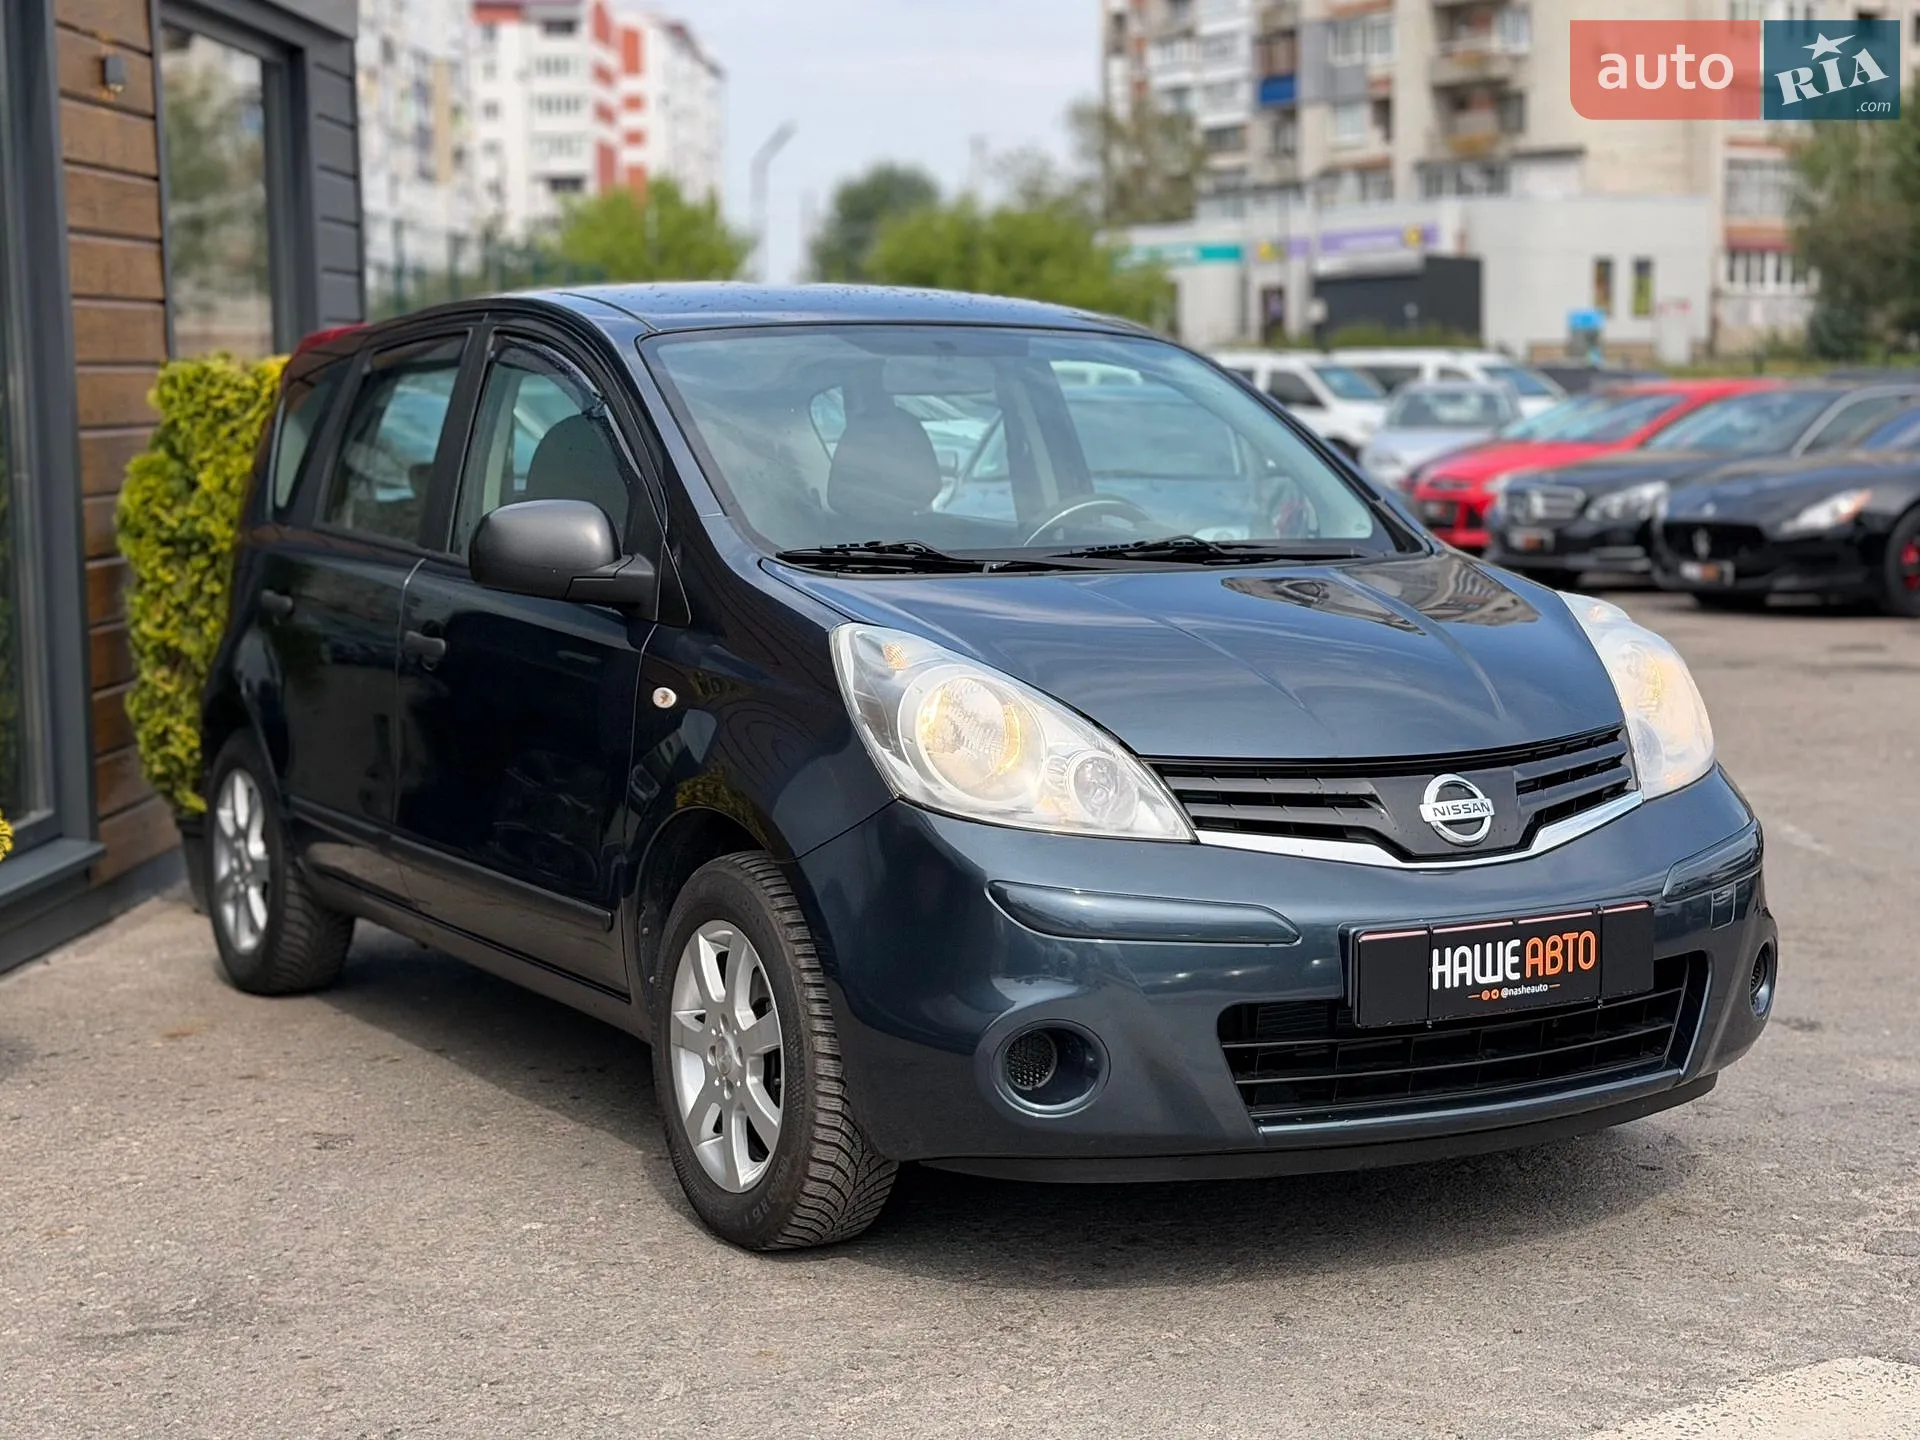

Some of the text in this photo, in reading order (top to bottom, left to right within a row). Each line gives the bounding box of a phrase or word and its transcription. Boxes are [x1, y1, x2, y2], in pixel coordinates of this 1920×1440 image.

[1432, 801, 1491, 817] NISSAN
[1431, 930, 1596, 990] НАШЕ АВТО
[1501, 983, 1548, 999] @nasheauto
